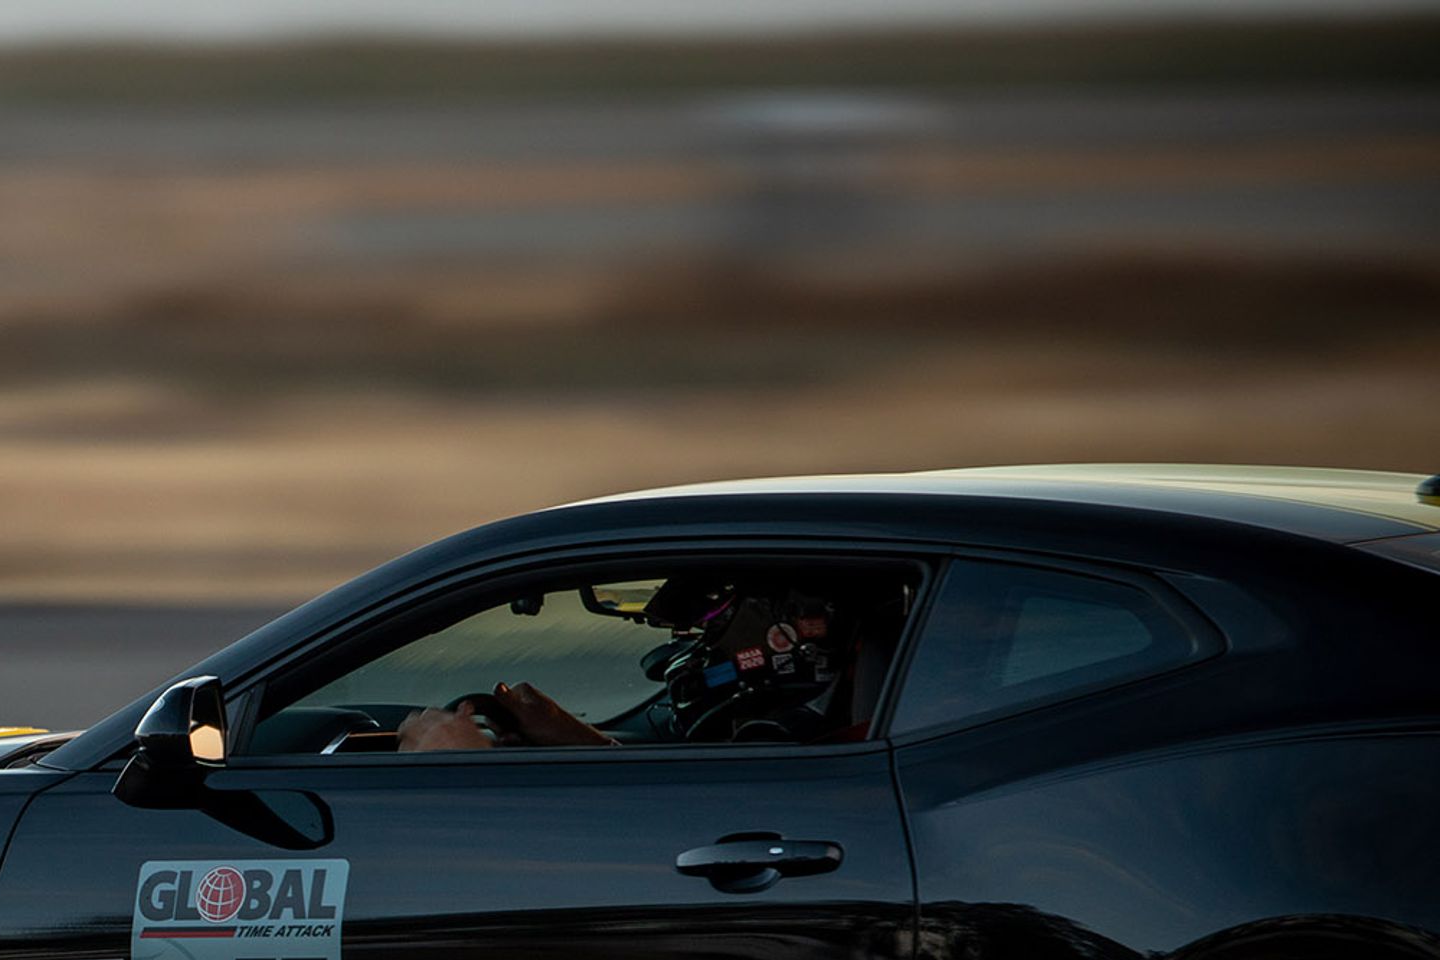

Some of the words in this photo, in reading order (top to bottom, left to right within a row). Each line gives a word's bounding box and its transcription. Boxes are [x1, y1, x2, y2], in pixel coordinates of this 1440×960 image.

[139, 866, 336, 922] GLOBAL
[238, 926, 271, 939] TIME
[274, 925, 335, 938] ATTACK
